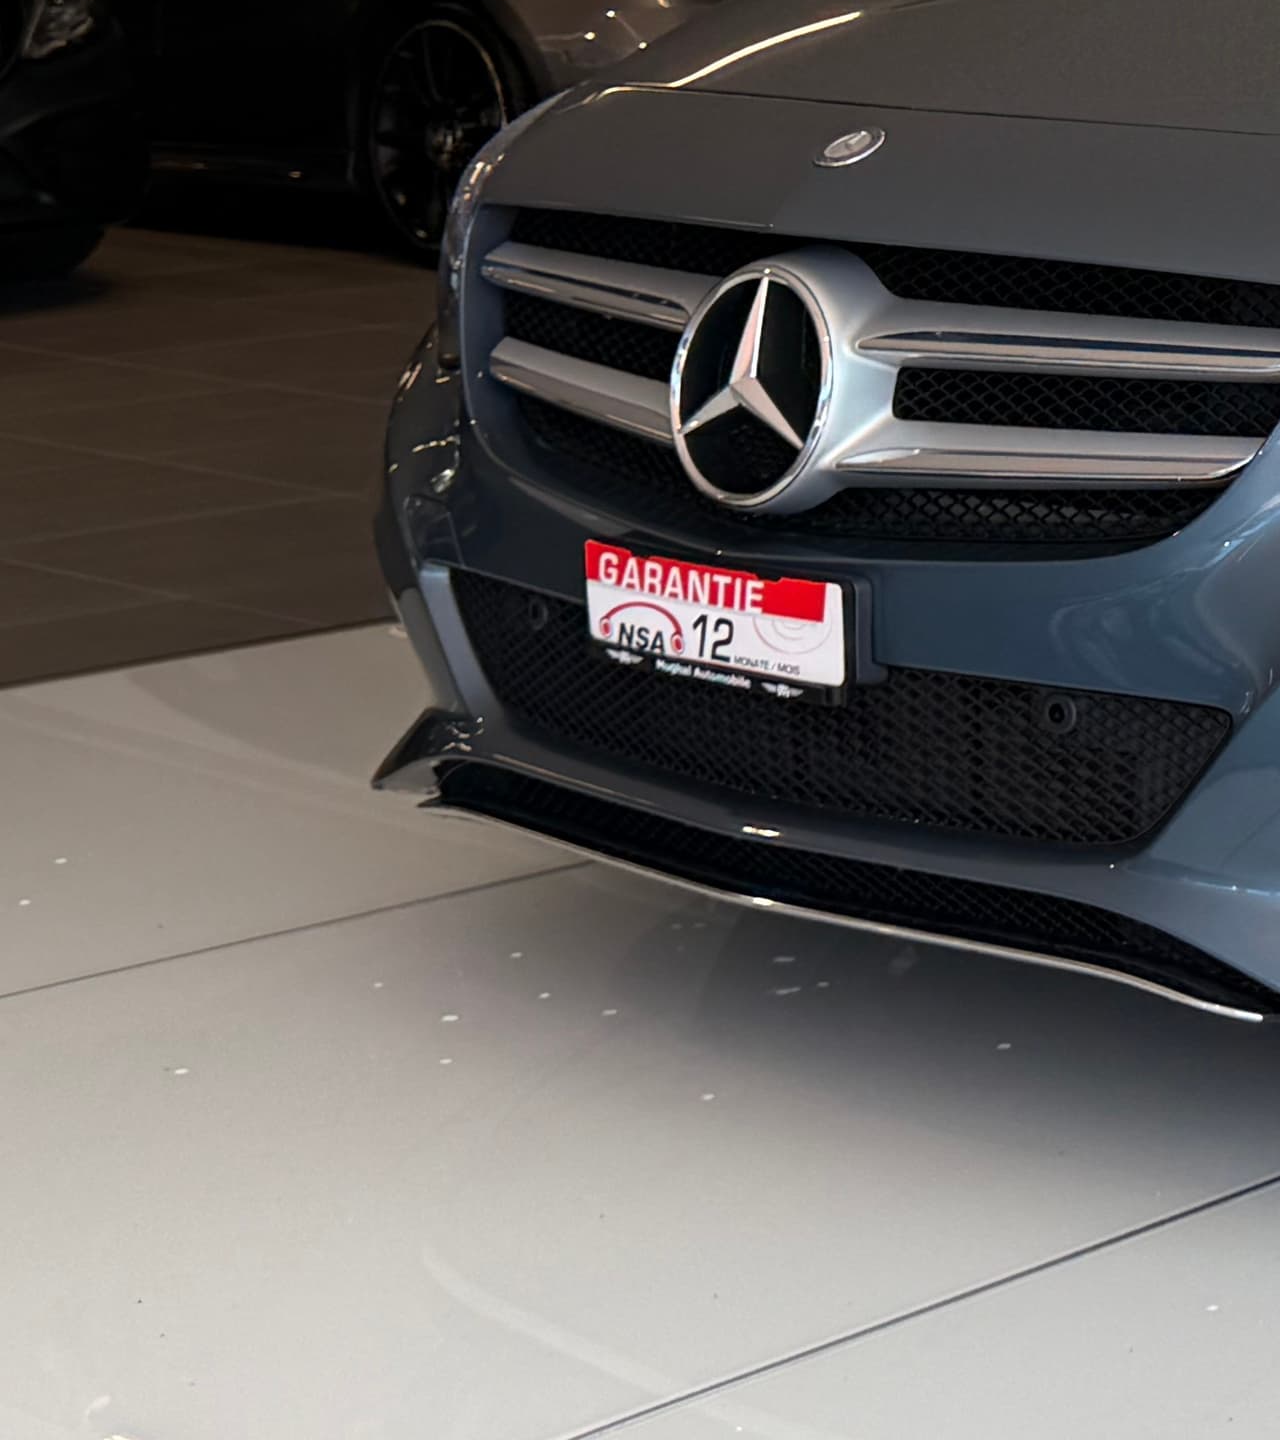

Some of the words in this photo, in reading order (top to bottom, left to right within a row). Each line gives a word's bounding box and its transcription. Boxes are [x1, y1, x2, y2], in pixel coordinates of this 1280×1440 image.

[599, 552, 764, 614] GARANTIE
[618, 623, 665, 655] NSA
[692, 613, 735, 663] 12
[777, 662, 801, 676] MOIS
